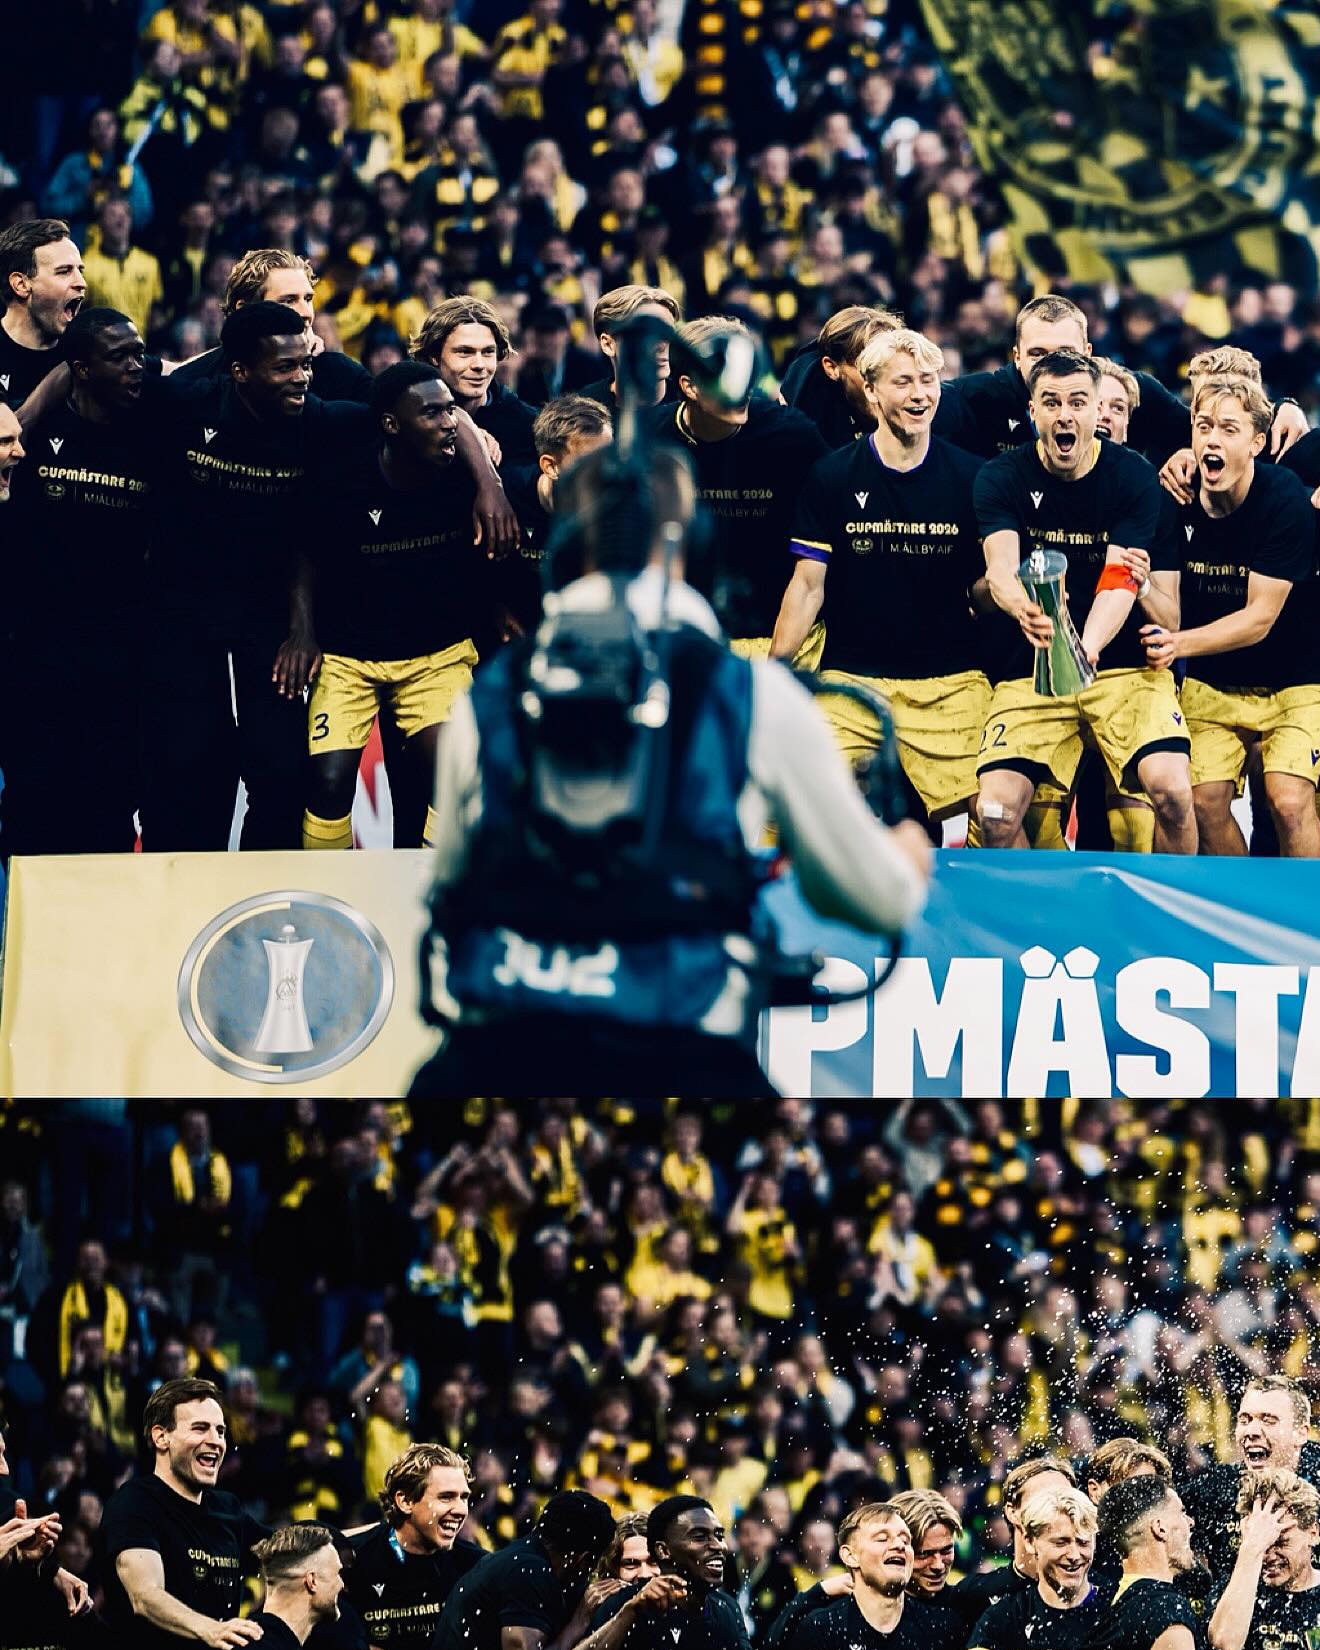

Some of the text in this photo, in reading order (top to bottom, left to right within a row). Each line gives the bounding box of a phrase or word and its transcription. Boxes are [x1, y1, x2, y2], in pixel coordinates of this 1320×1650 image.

[37, 464, 124, 488] CUPMÄSTARE
[844, 519, 960, 537] CUPMÄSTARE 2026
[889, 542, 954, 556] MÄLLBY AIF
[311, 712, 330, 742] 3
[361, 1602, 440, 1622] CUPMÄSTARE
